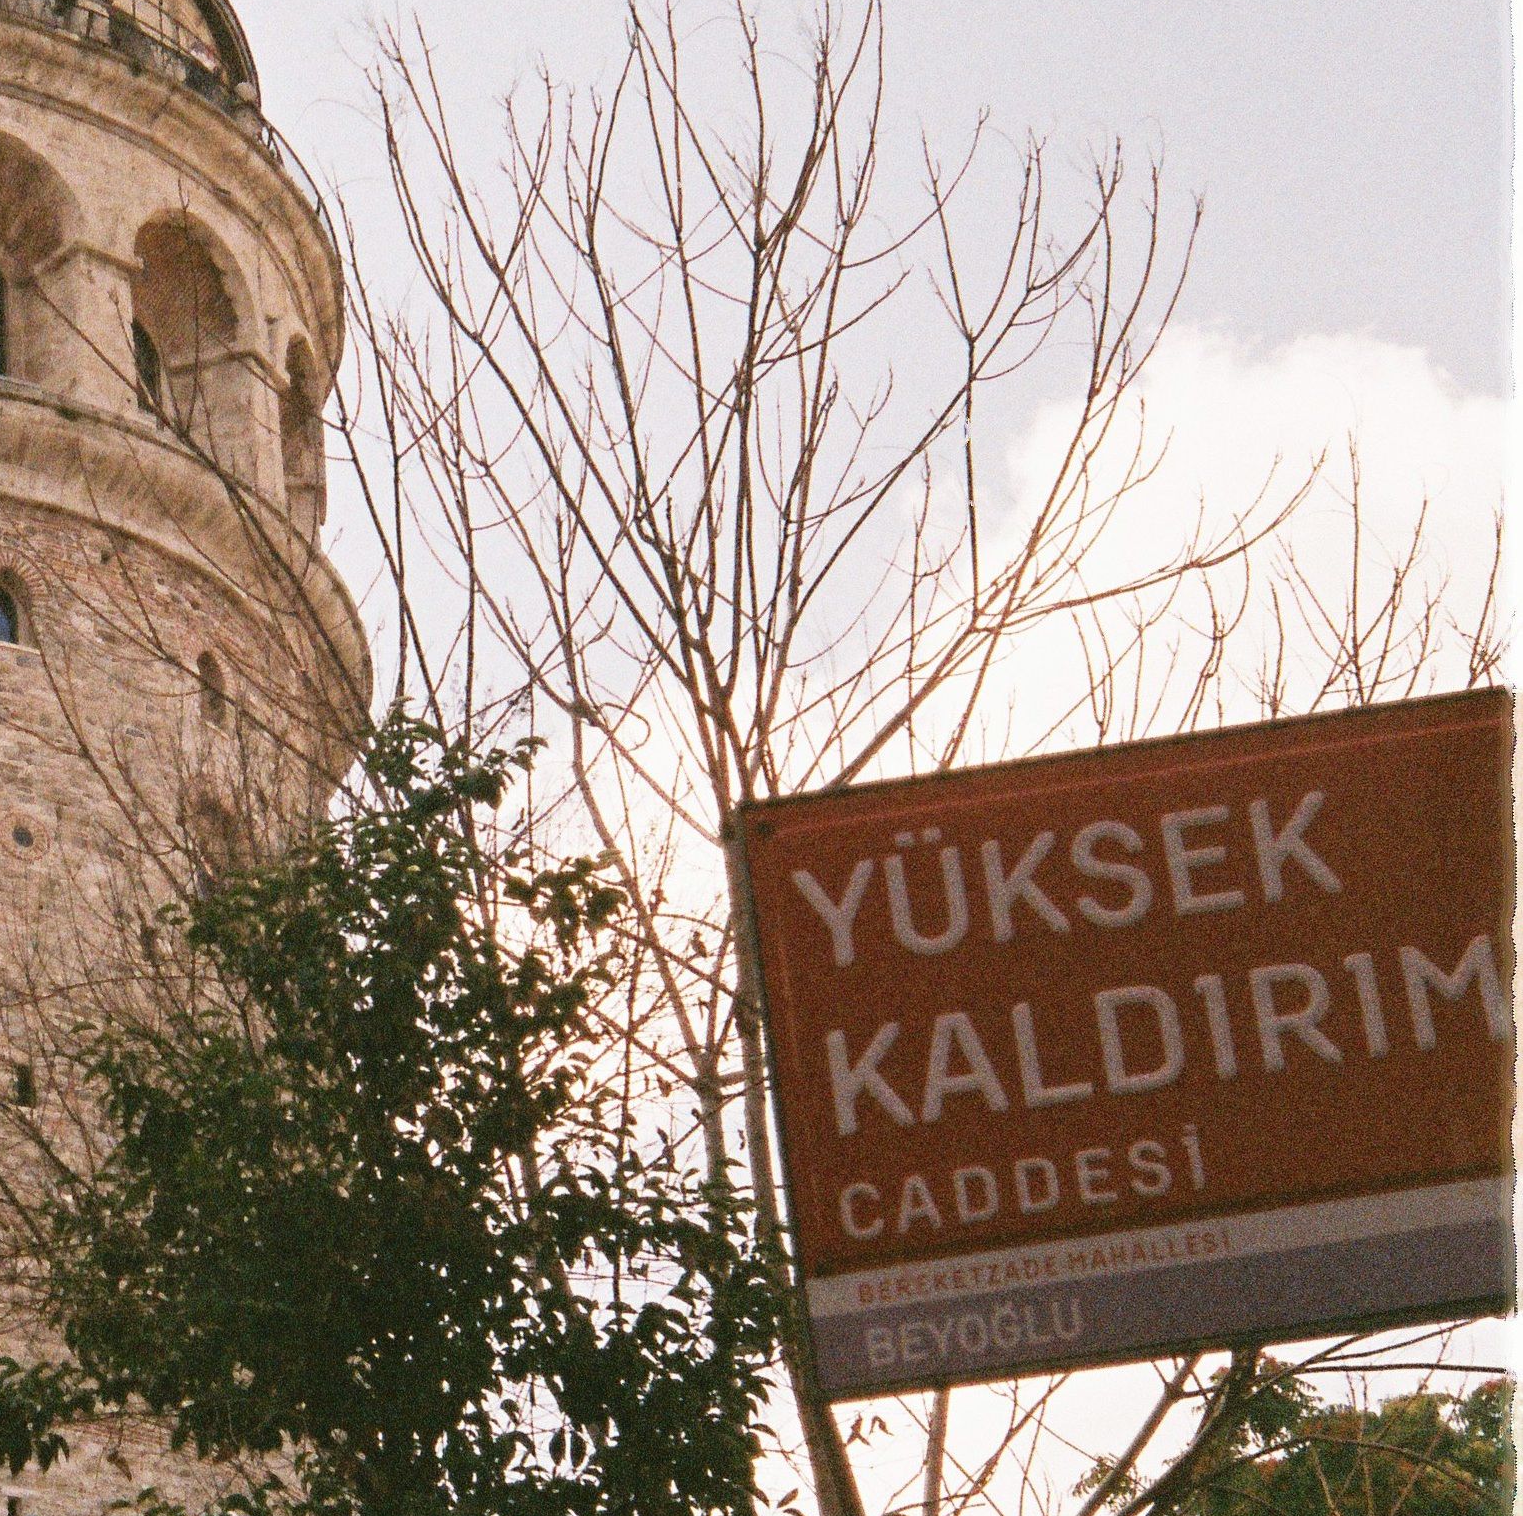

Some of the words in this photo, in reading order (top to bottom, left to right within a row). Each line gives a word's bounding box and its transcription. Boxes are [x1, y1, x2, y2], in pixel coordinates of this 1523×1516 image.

[792, 790, 1343, 968] YÜKSEK
[824, 934, 1506, 1136] KALDIRIM
[838, 1122, 1209, 1241] CADDESİ
[857, 1258, 1059, 1304] BEREKETZADE
[864, 1298, 1086, 1368] BEYOĞLU
